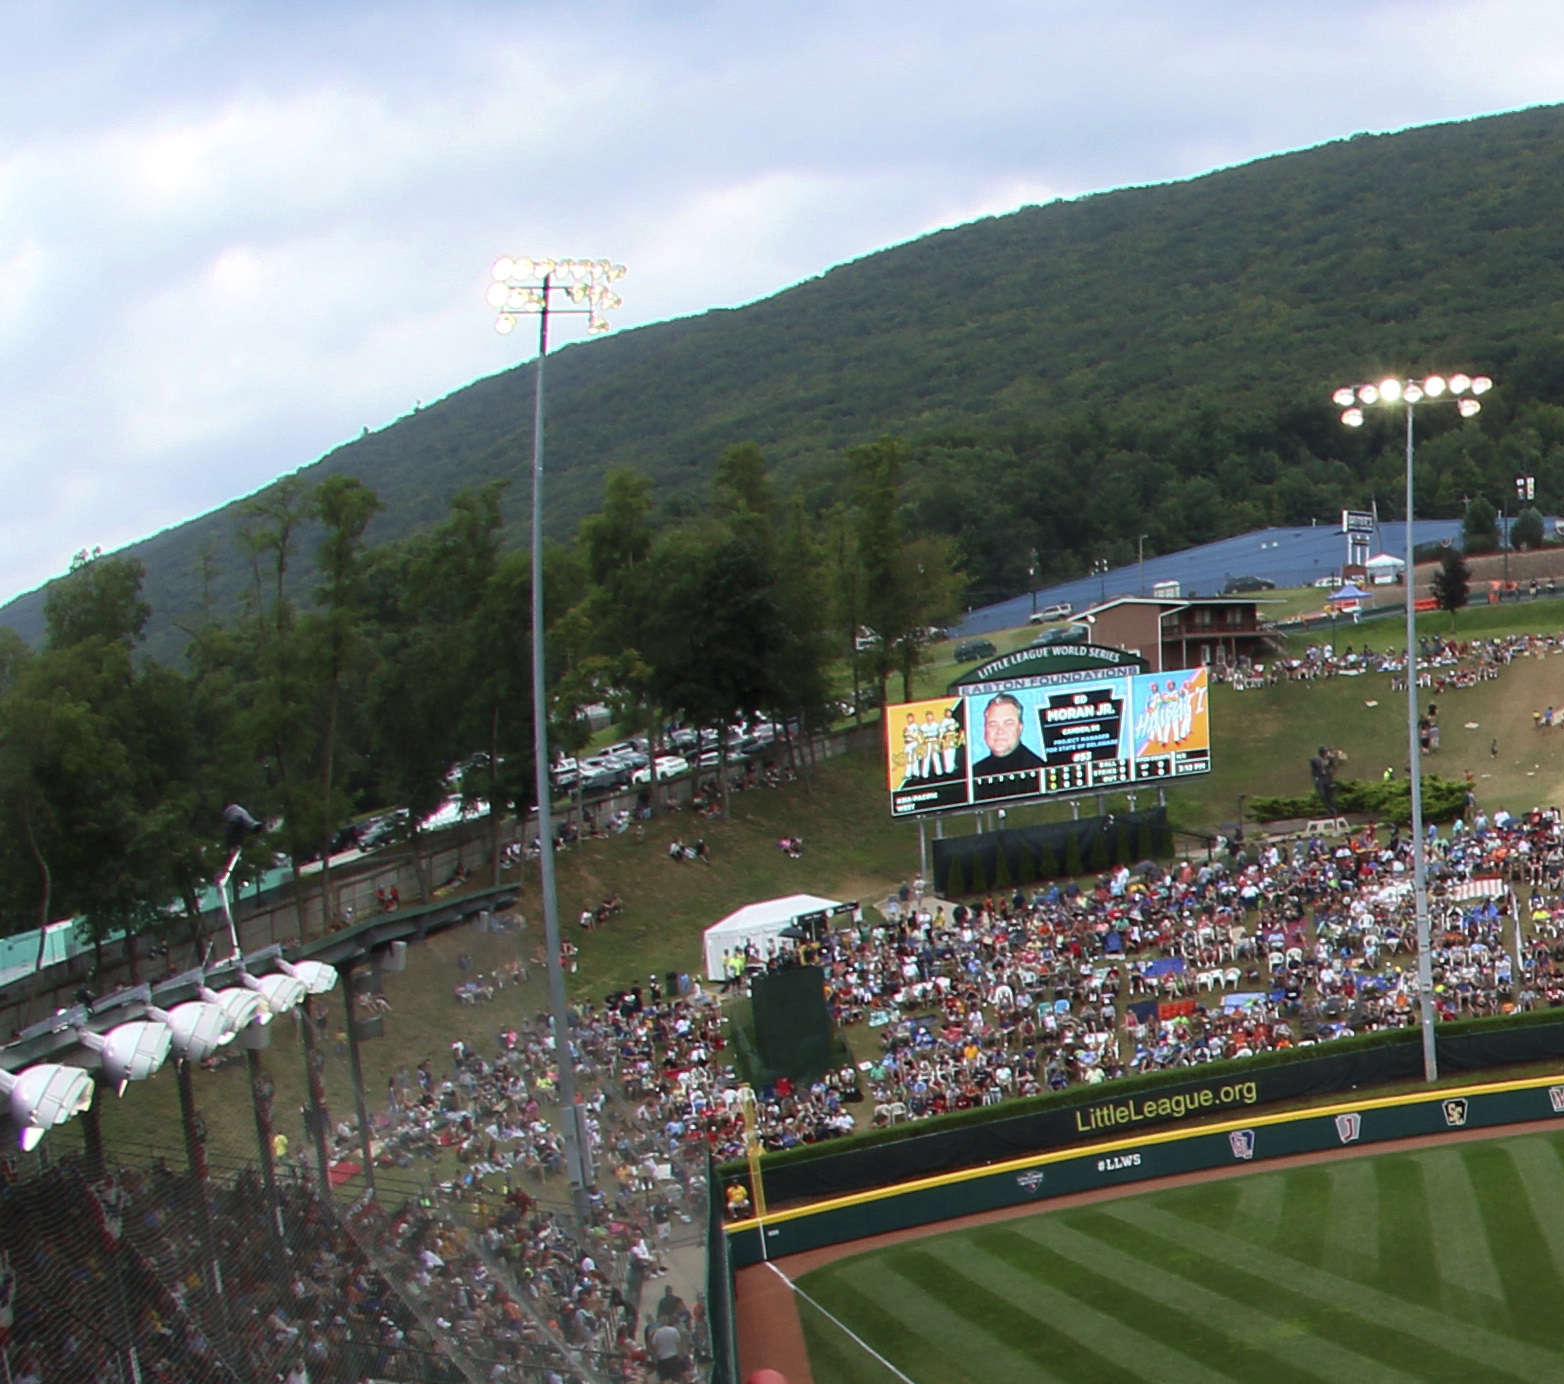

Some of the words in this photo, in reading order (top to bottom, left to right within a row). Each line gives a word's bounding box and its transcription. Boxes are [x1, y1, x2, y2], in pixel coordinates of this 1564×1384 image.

[977, 659, 1011, 680] LITTLE
[1011, 646, 1050, 665] LEAGUE
[1052, 645, 1087, 657] WORLD
[1088, 647, 1120, 663] SERIES
[962, 677, 1026, 695] EASTON
[1030, 665, 1139, 685] FOUNDATIONS
[1046, 704, 1095, 722] MORAN
[1075, 1081, 1257, 1132] LittleLeague.org
[1097, 1153, 1142, 1172] #LLWS
